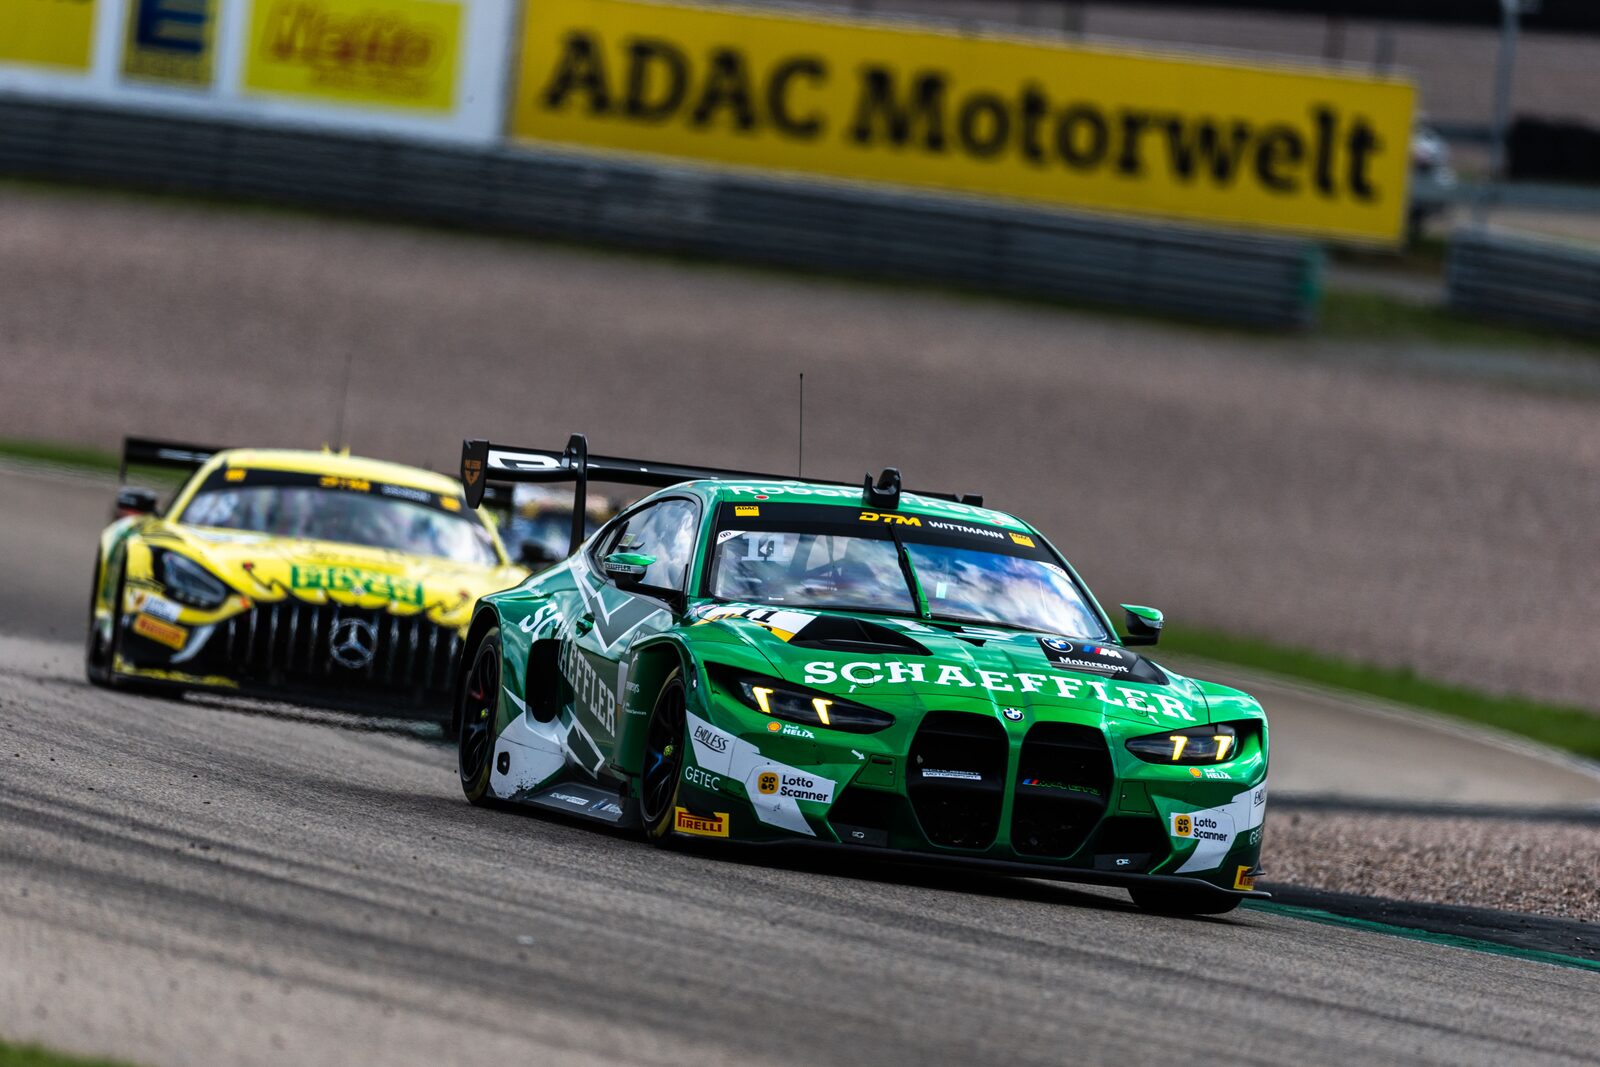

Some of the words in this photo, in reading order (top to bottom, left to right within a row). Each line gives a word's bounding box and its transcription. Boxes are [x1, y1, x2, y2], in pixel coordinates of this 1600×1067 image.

[541, 30, 828, 142] ADAC
[846, 62, 1385, 202] Motorwelt
[858, 511, 922, 527] DTM
[928, 520, 1004, 540] WITTMANN
[1058, 656, 1129, 673] Motorsport
[804, 661, 1196, 721] SCHAEFFLER
[694, 725, 729, 752] ENDLESS
[782, 727, 815, 739] HELIX
[685, 766, 720, 791] GETEC
[782, 775, 813, 789] Lotto
[1205, 771, 1232, 780] HELIX
[780, 786, 829, 802] Scanner
[678, 811, 724, 832] PIRELLI
[1193, 817, 1217, 829] Lotto
[1193, 828, 1228, 842] Scanner
